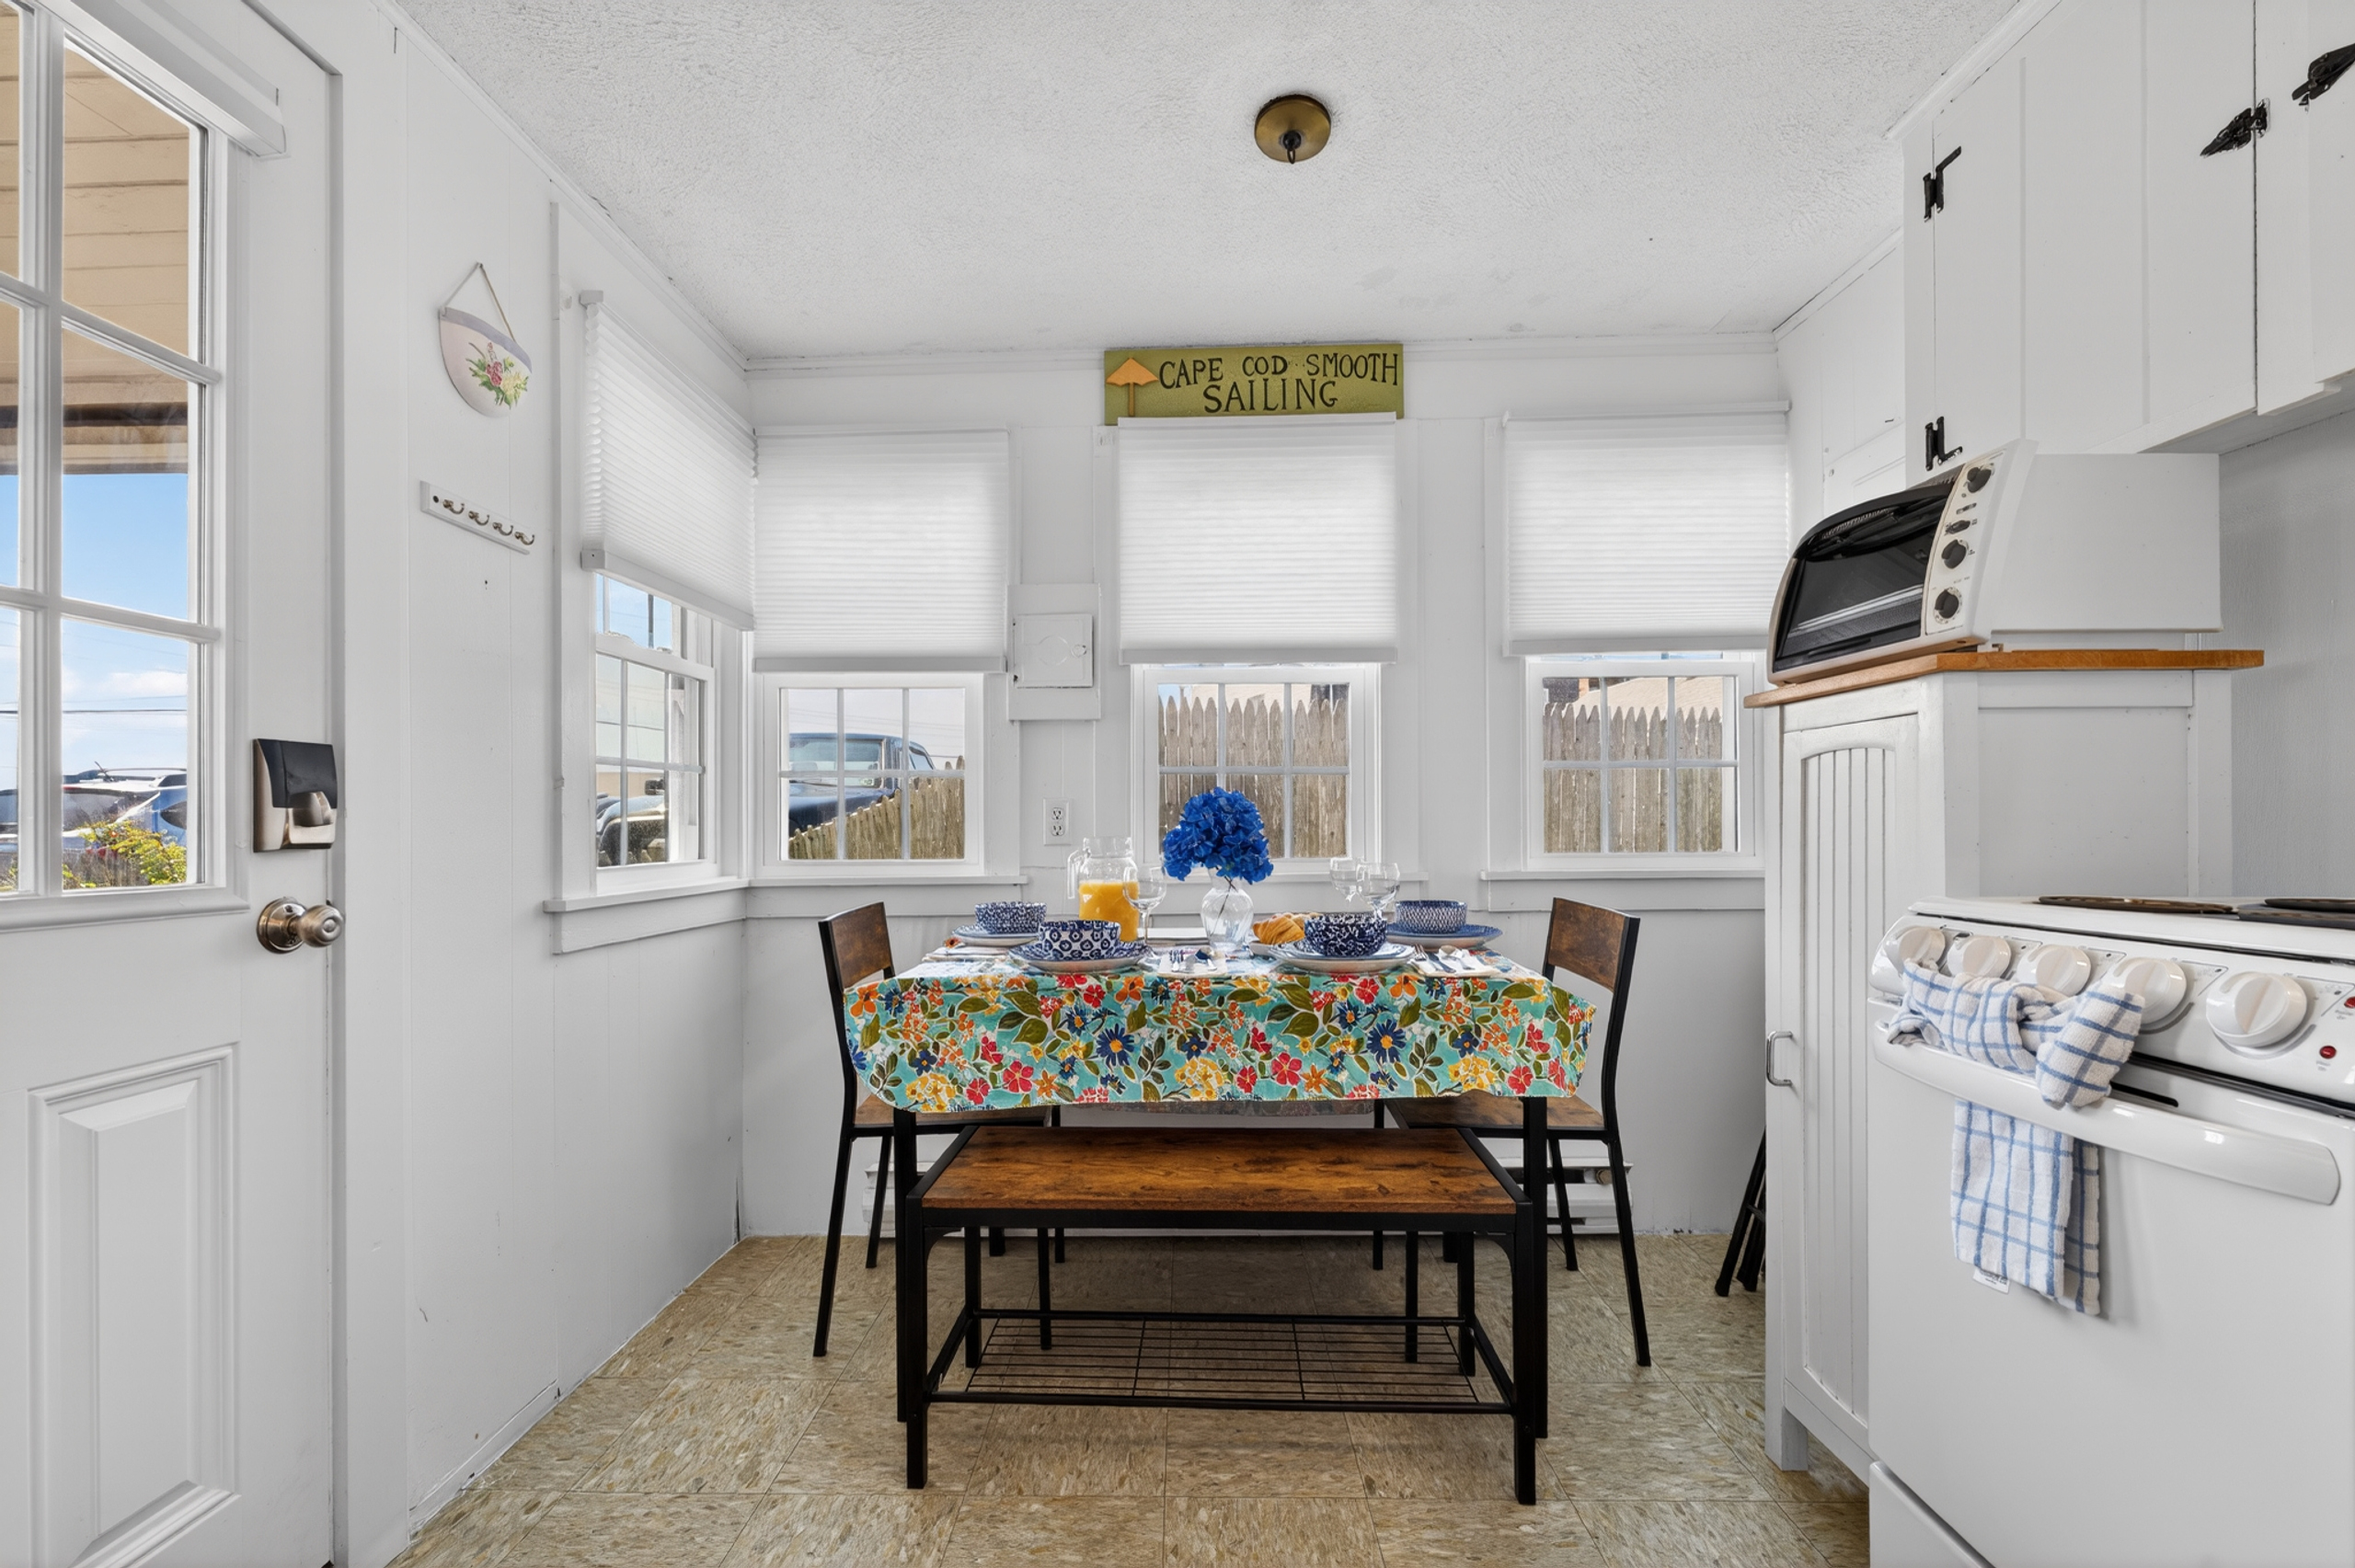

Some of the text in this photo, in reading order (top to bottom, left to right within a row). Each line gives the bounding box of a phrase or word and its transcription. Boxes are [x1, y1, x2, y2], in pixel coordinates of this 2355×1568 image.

[1159, 353, 1398, 388] CAPE COD SMOOTH
[1202, 378, 1338, 413] SAILING
